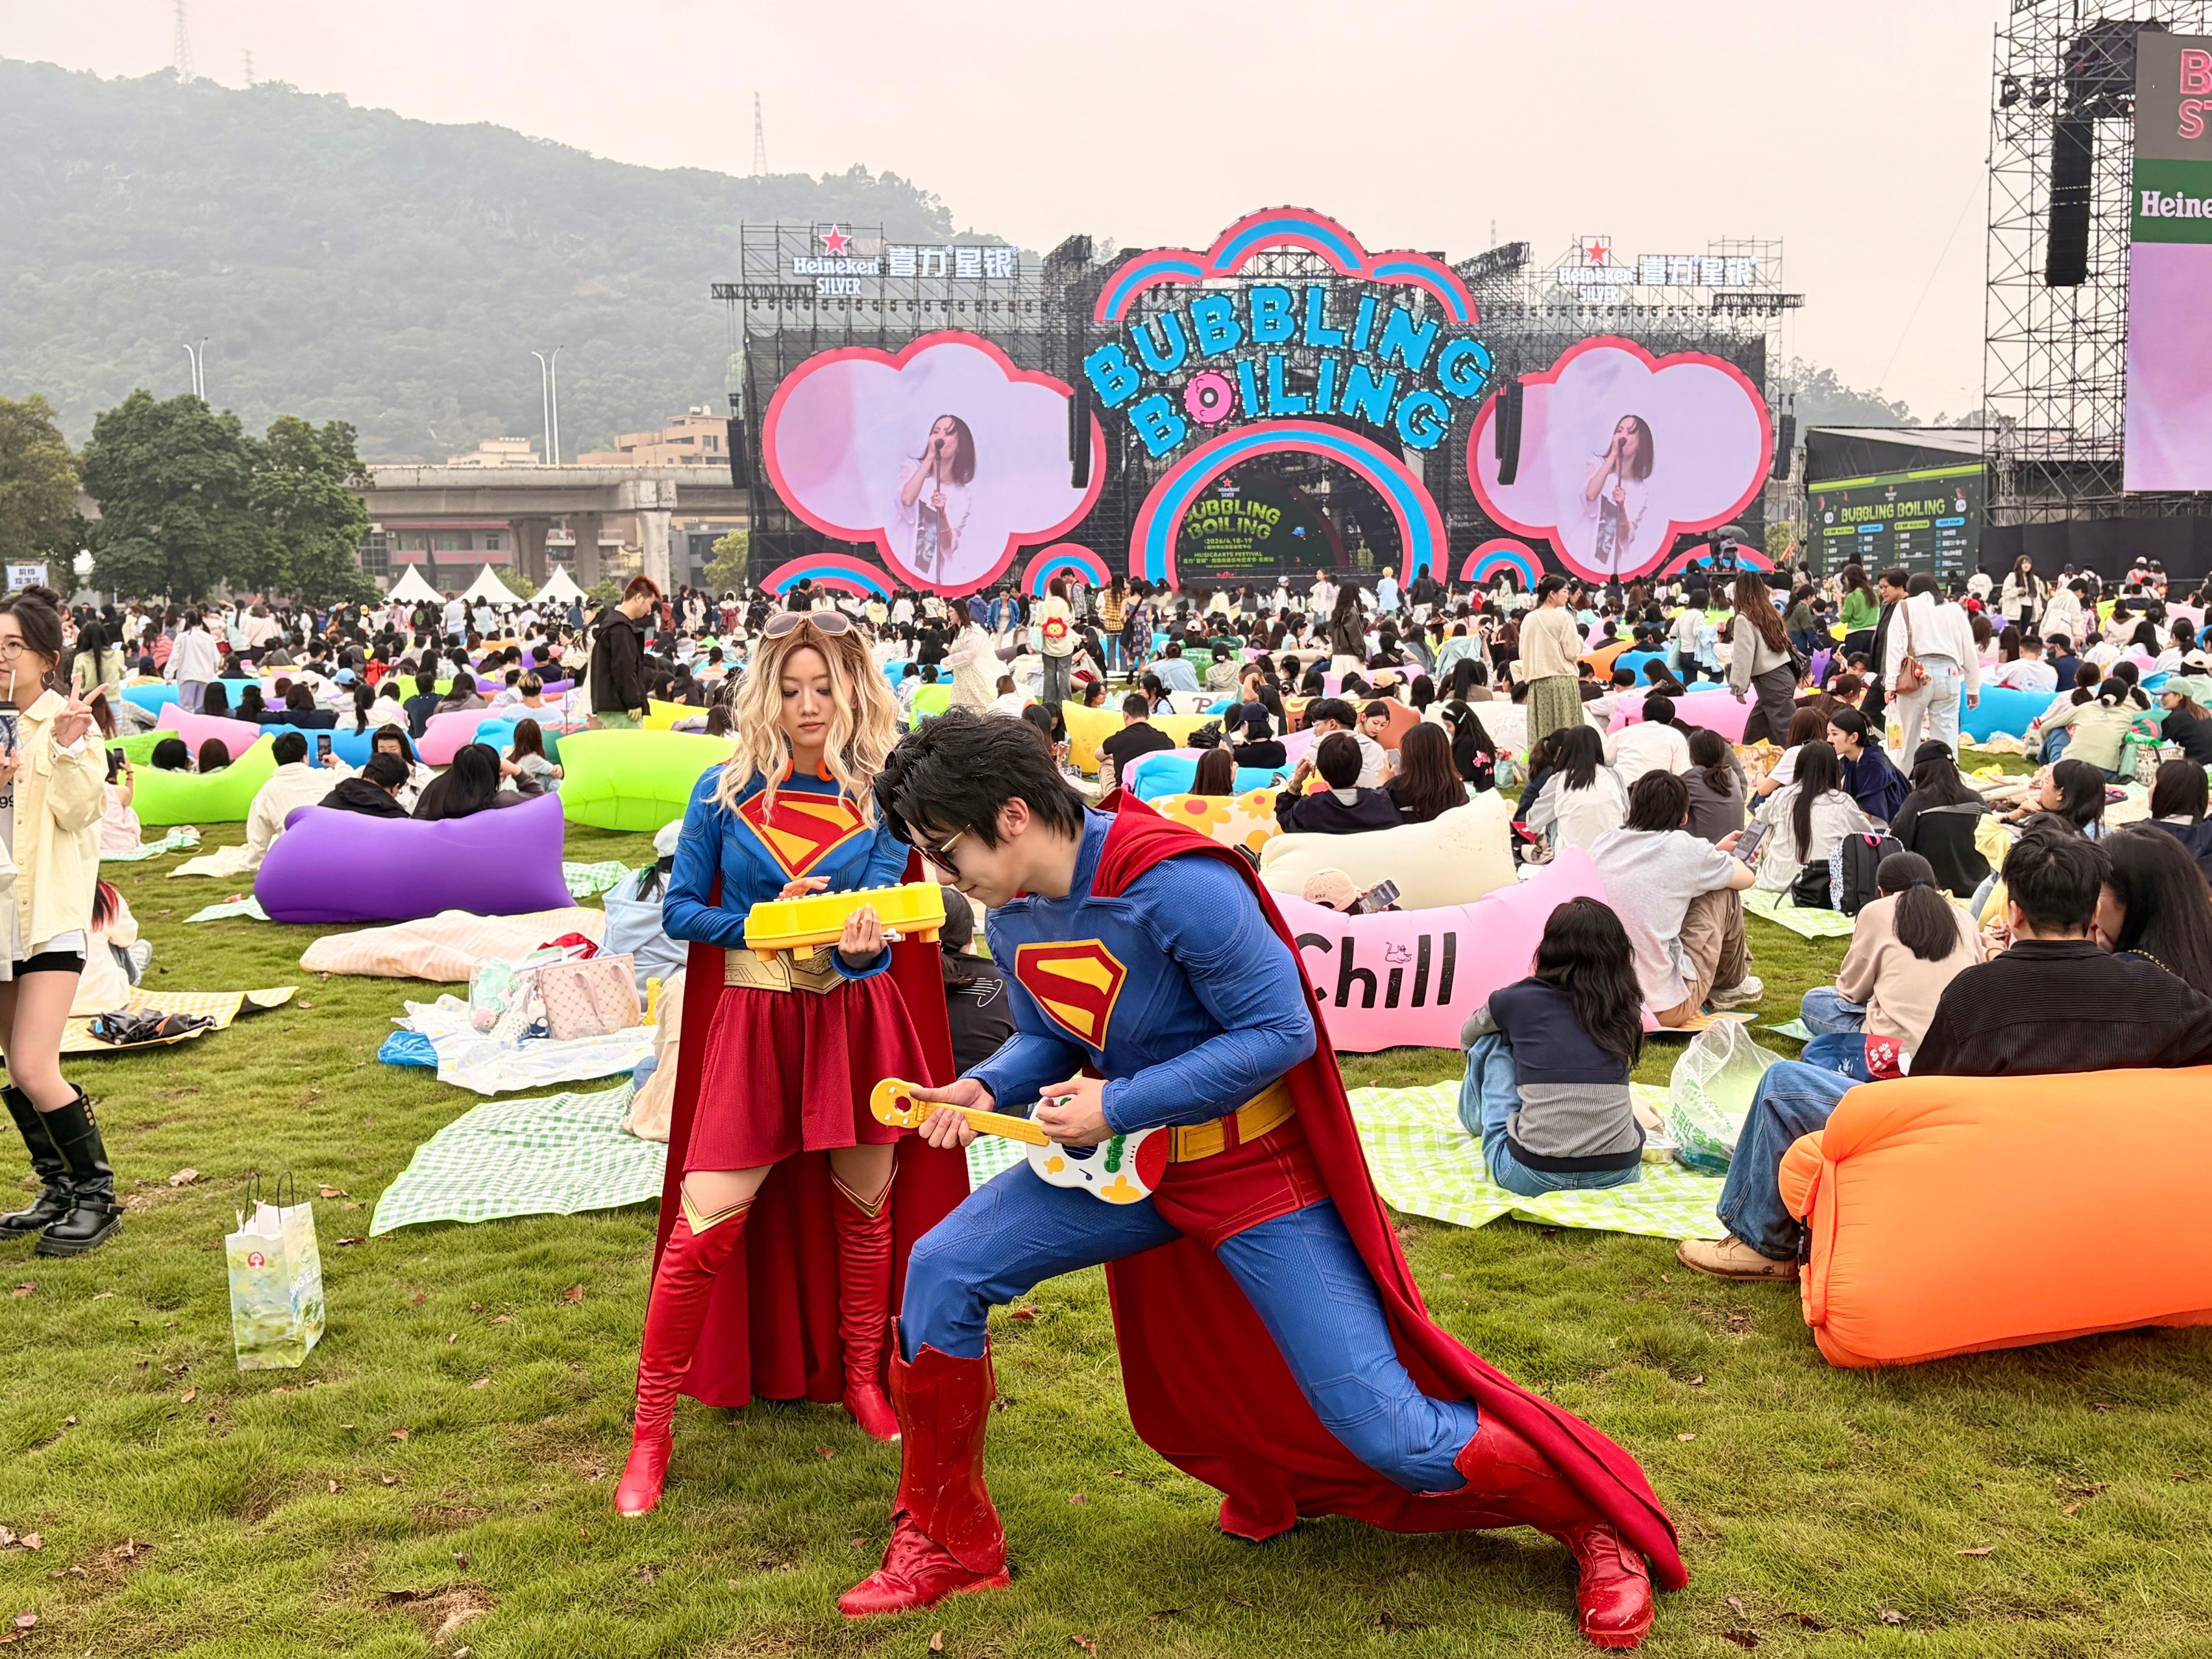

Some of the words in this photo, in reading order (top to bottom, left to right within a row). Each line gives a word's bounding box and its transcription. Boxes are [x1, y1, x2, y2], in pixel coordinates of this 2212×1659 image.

[2140, 191, 2212, 218] Heine
[793, 257, 880, 275] Heineken
[1558, 266, 1634, 284] Heineken
[816, 277, 861, 295] SILVER
[1579, 285, 1618, 302] SILVER
[1083, 284, 1493, 409] BUBBLING
[1127, 353, 1451, 458] BOILING
[1841, 503, 1894, 523] BUBBLING
[1898, 498, 1945, 517] BOILING
[1187, 517, 1271, 540] BOILING
